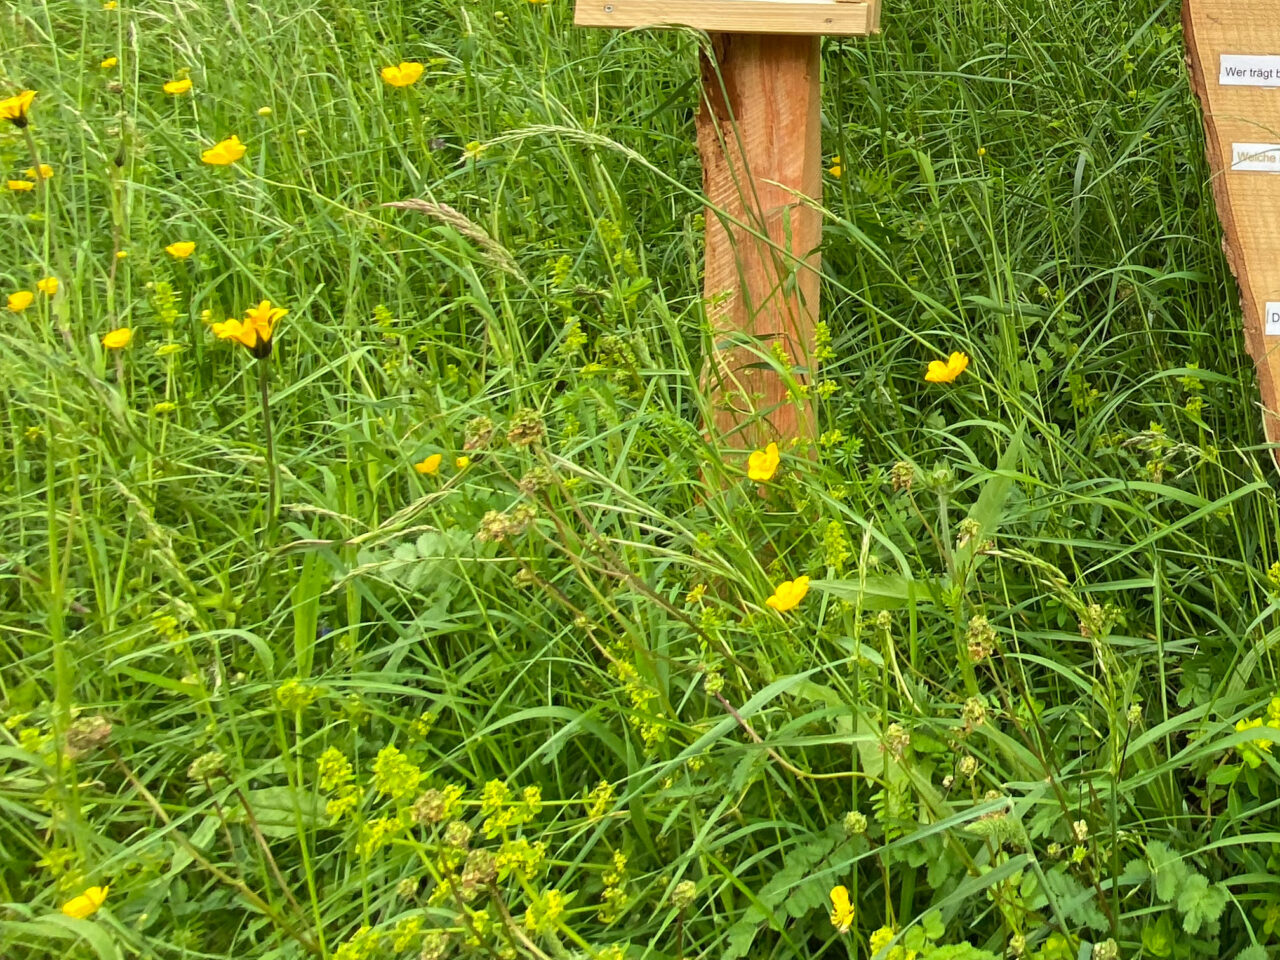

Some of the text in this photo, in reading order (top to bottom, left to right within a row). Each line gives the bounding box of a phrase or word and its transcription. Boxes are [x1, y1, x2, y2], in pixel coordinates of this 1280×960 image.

[1225, 67, 1246, 77] Wer
[1249, 68, 1273, 80] trägt
[1237, 151, 1276, 163] Welche
